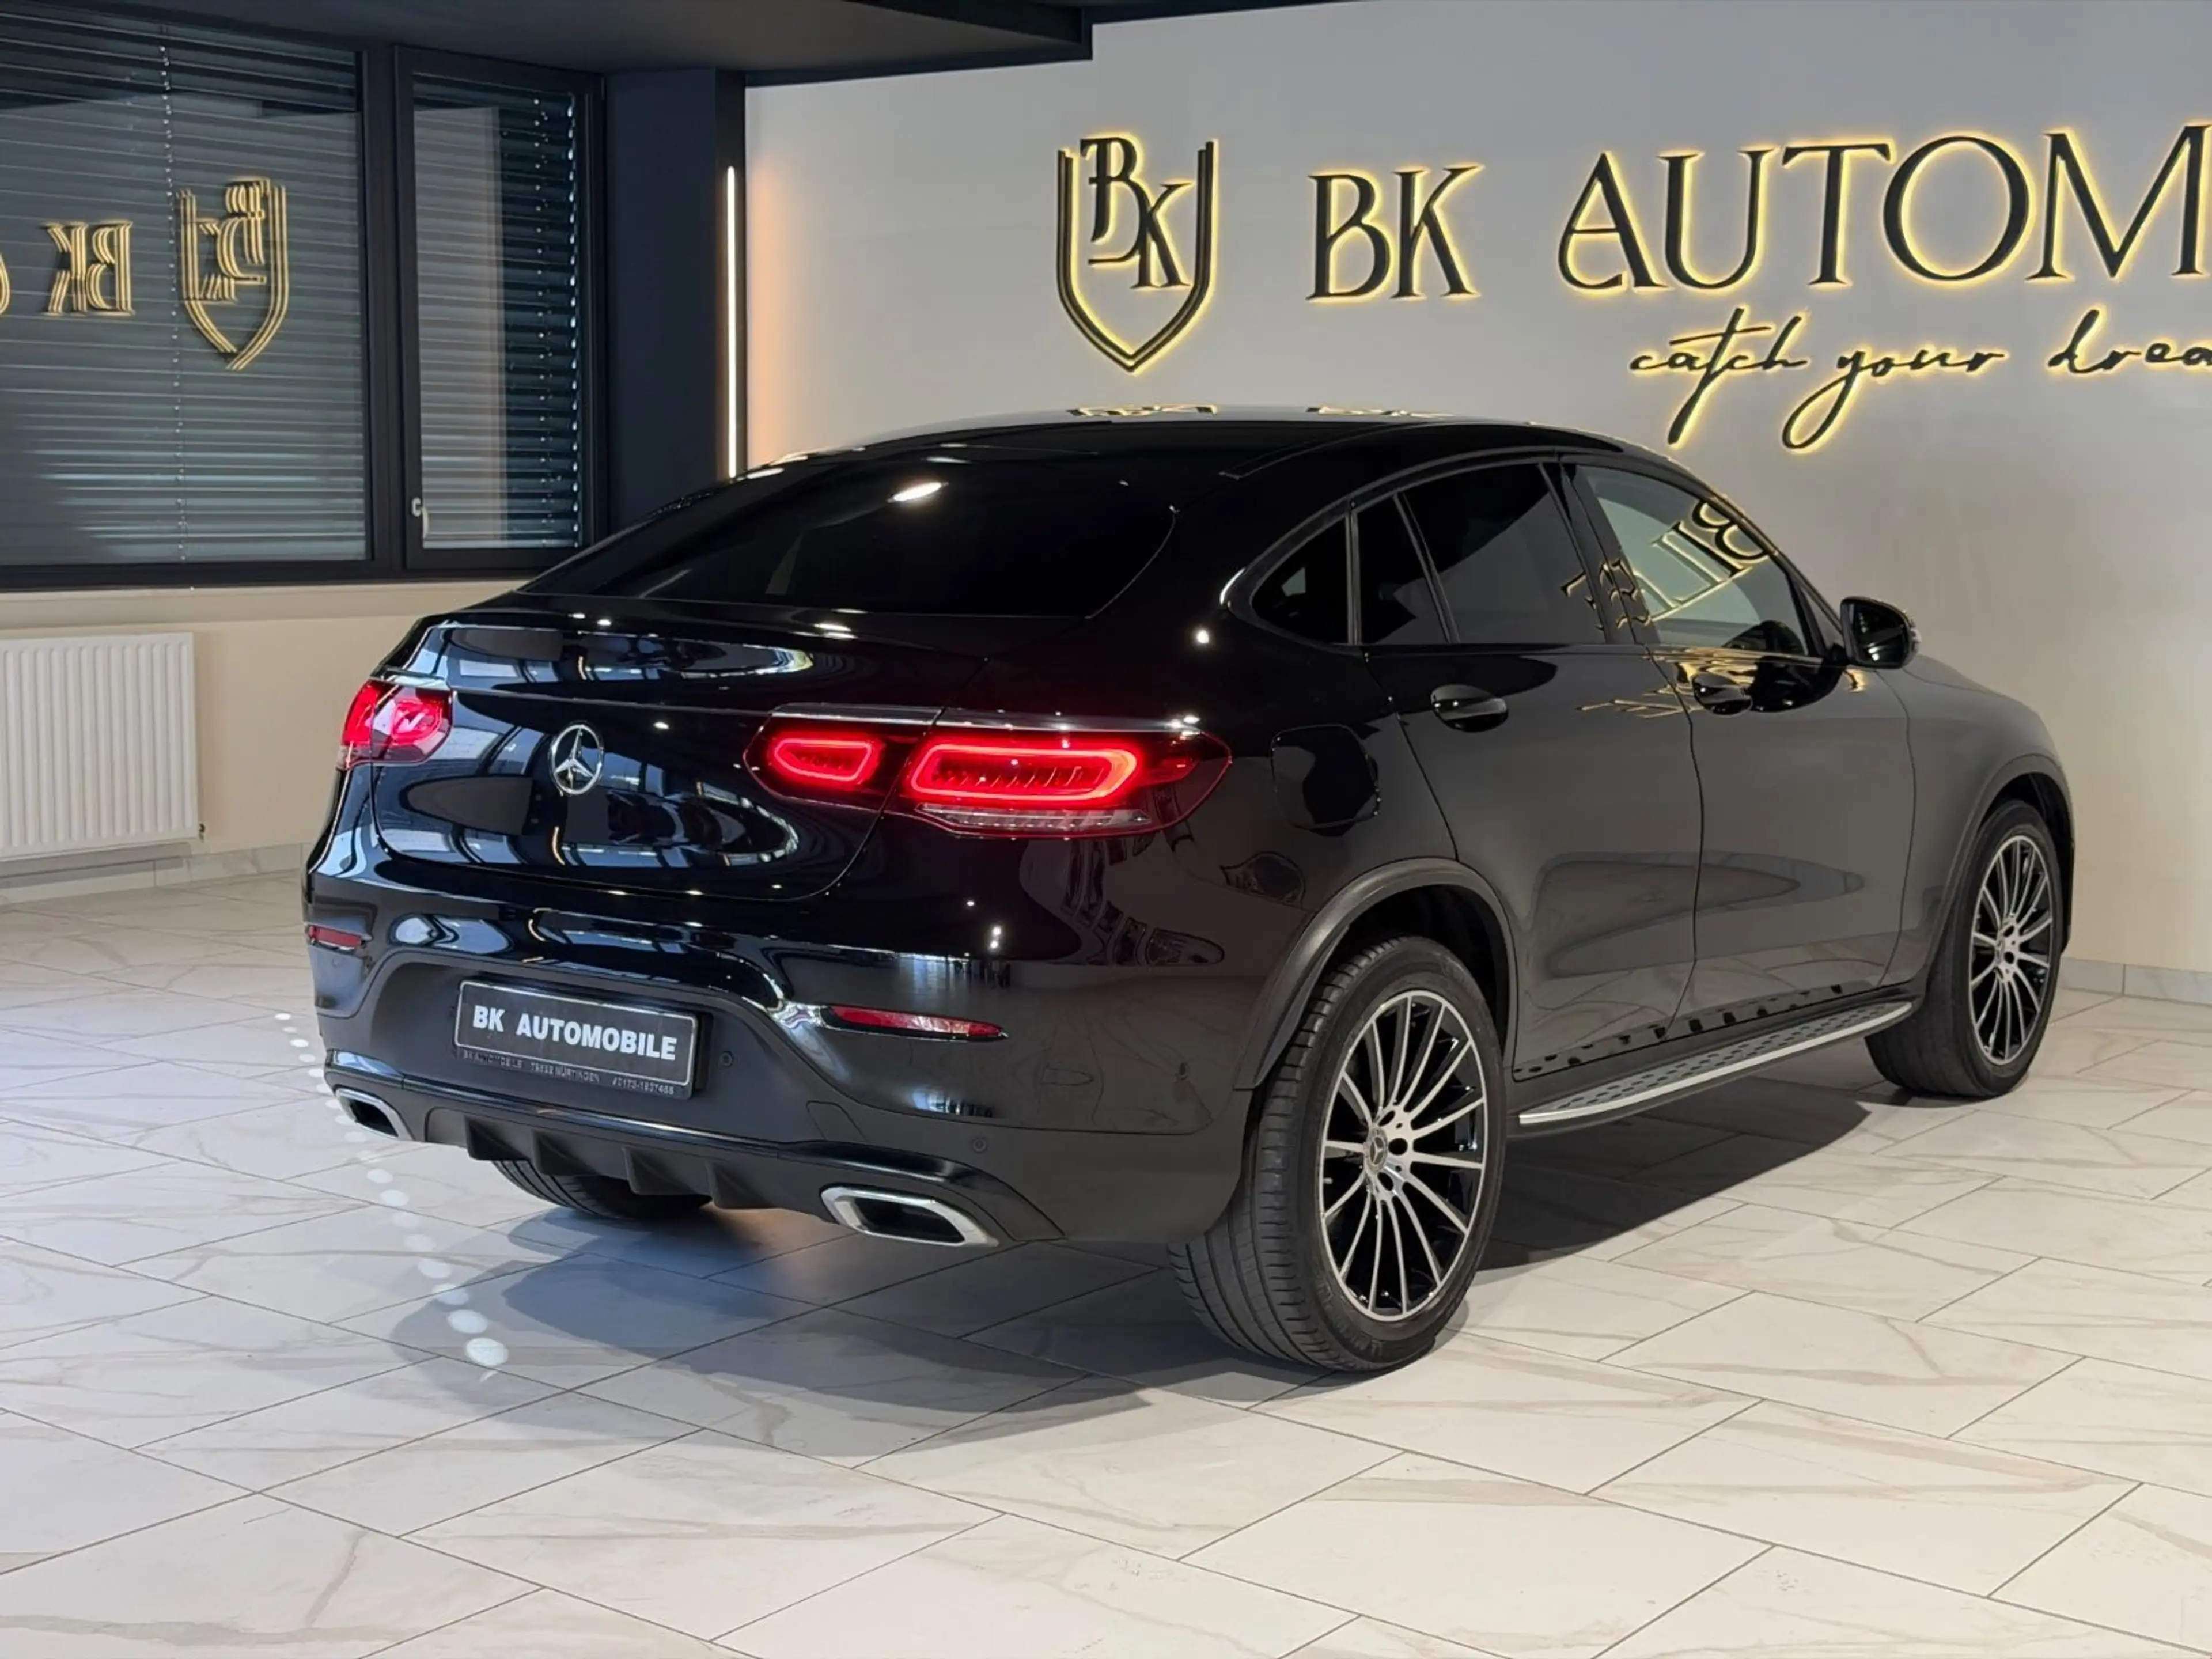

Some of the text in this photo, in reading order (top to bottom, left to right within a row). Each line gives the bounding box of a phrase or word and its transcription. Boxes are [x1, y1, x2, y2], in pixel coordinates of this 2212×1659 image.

[1305, 124, 2212, 301] BK AUTOM
[1629, 306, 1810, 446] catch
[1781, 349, 2006, 449] your
[472, 1005, 678, 1061] BK AUTOMOBILE
